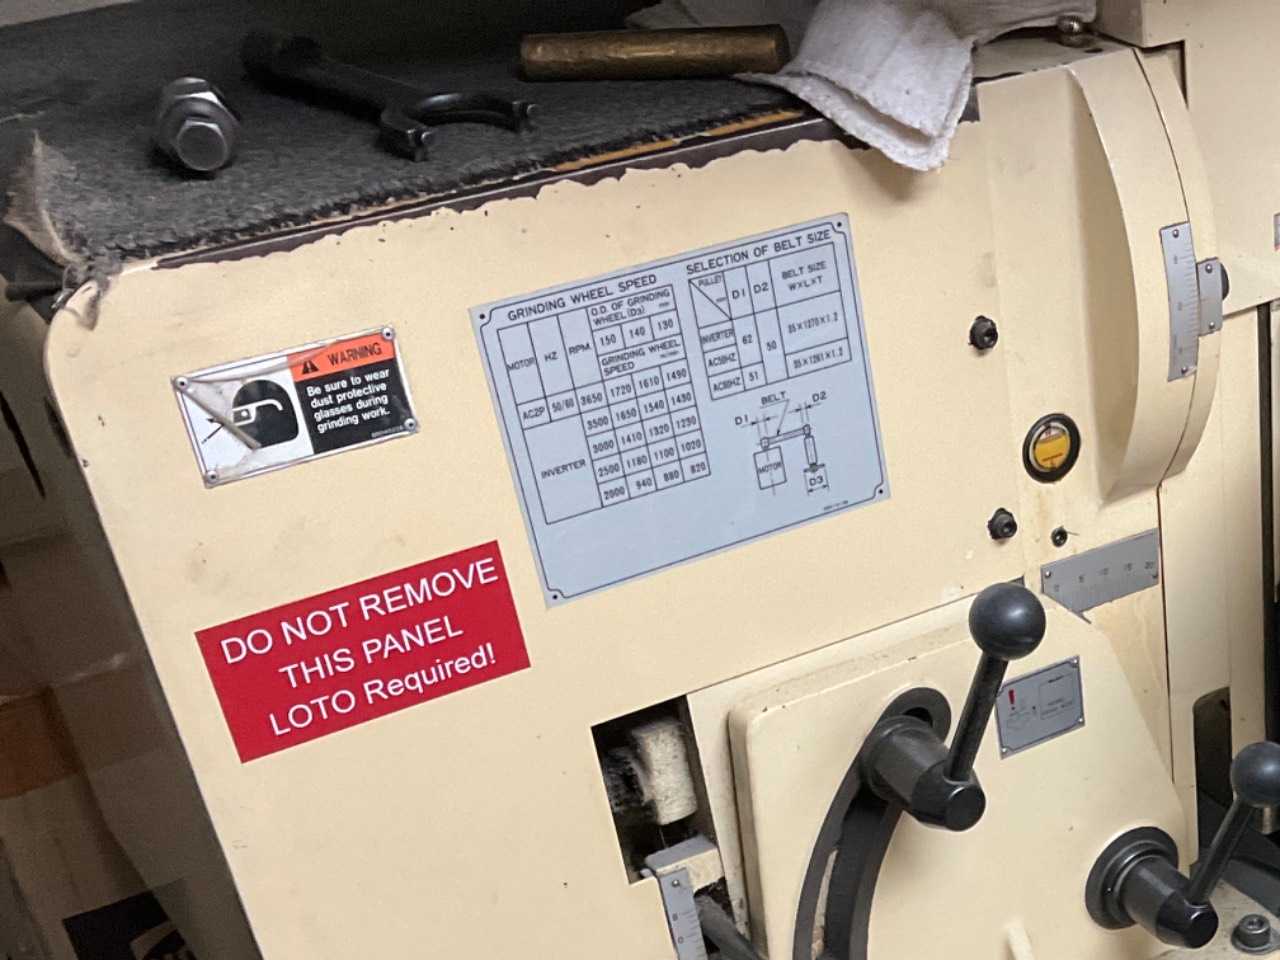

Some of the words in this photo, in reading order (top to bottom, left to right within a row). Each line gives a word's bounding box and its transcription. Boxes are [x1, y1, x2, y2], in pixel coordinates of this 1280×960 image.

[686, 250, 749, 275] SELECTION
[753, 245, 769, 258] OF
[774, 236, 802, 252] BELT
[807, 229, 831, 244] SIZE
[781, 266, 805, 280] BELT
[808, 261, 827, 273] SIZE
[507, 297, 566, 321] GRINDING
[569, 286, 613, 304] WHEEL
[618, 274, 657, 292] SPEED
[611, 300, 624, 311] OF
[627, 288, 670, 307] GRINDING
[753, 282, 769, 294] D2
[600, 334, 616, 346] 150
[629, 326, 645, 338] 140
[657, 319, 673, 331] 130
[700, 329, 734, 344] INVERTER
[742, 334, 753, 345] 62
[766, 340, 777, 351] 50
[327, 342, 382, 366] WARNING
[506, 356, 537, 371] MOTOR
[544, 351, 559, 362] HZ
[568, 342, 592, 355] RPM
[601, 348, 645, 366] GRINDING
[648, 339, 680, 353] WHEEL
[603, 361, 635, 376] SPEED
[306, 386, 321, 397] Be
[324, 379, 347, 393] sure
[350, 376, 361, 386] to
[365, 369, 390, 382] wear
[310, 395, 333, 409] dust
[336, 383, 387, 404] protective
[522, 406, 545, 420] AC2P
[610, 384, 632, 398] 1720
[639, 376, 660, 389] 1610
[666, 368, 687, 381] 1490
[812, 391, 827, 402] D2
[314, 404, 353, 422] glasses
[356, 395, 388, 410] during
[643, 399, 665, 413] 1540
[760, 390, 786, 405] BELT
[317, 415, 359, 434] grinding
[361, 407, 390, 421] work.
[621, 431, 642, 445] 1410
[649, 423, 670, 437] 1320
[541, 458, 586, 479] INVERTER
[597, 463, 620, 477] 2500
[654, 447, 675, 460] 1100
[681, 439, 701, 453] 1020
[809, 475, 824, 486] D3
[220, 629, 273, 665] DO
[280, 602, 348, 647] NOT
[359, 557, 498, 621] REMOVE
[278, 647, 356, 690] THIS
[363, 614, 463, 660] PANEL
[268, 689, 356, 737] LOTO
[366, 642, 496, 705] Required!
